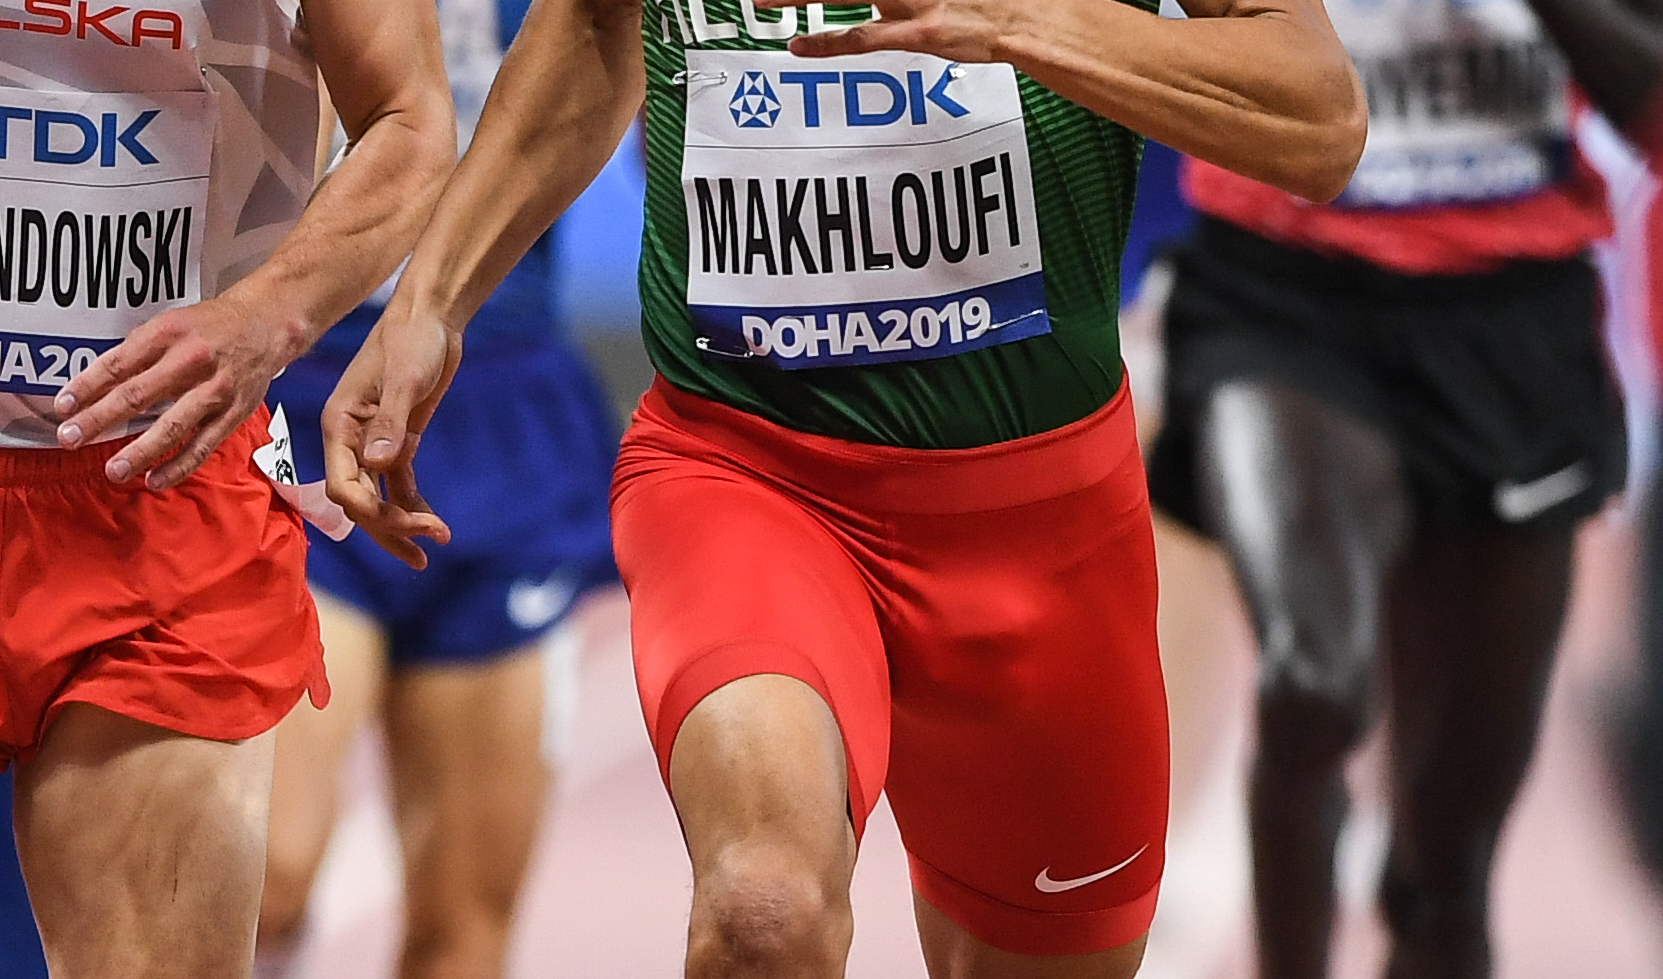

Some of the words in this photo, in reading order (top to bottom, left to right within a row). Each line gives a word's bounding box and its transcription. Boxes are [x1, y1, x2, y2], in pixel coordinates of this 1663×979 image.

[779, 63, 972, 128] TDK
[693, 151, 1021, 276] MAKHLOUFI
[740, 295, 991, 359] DOHA2019
